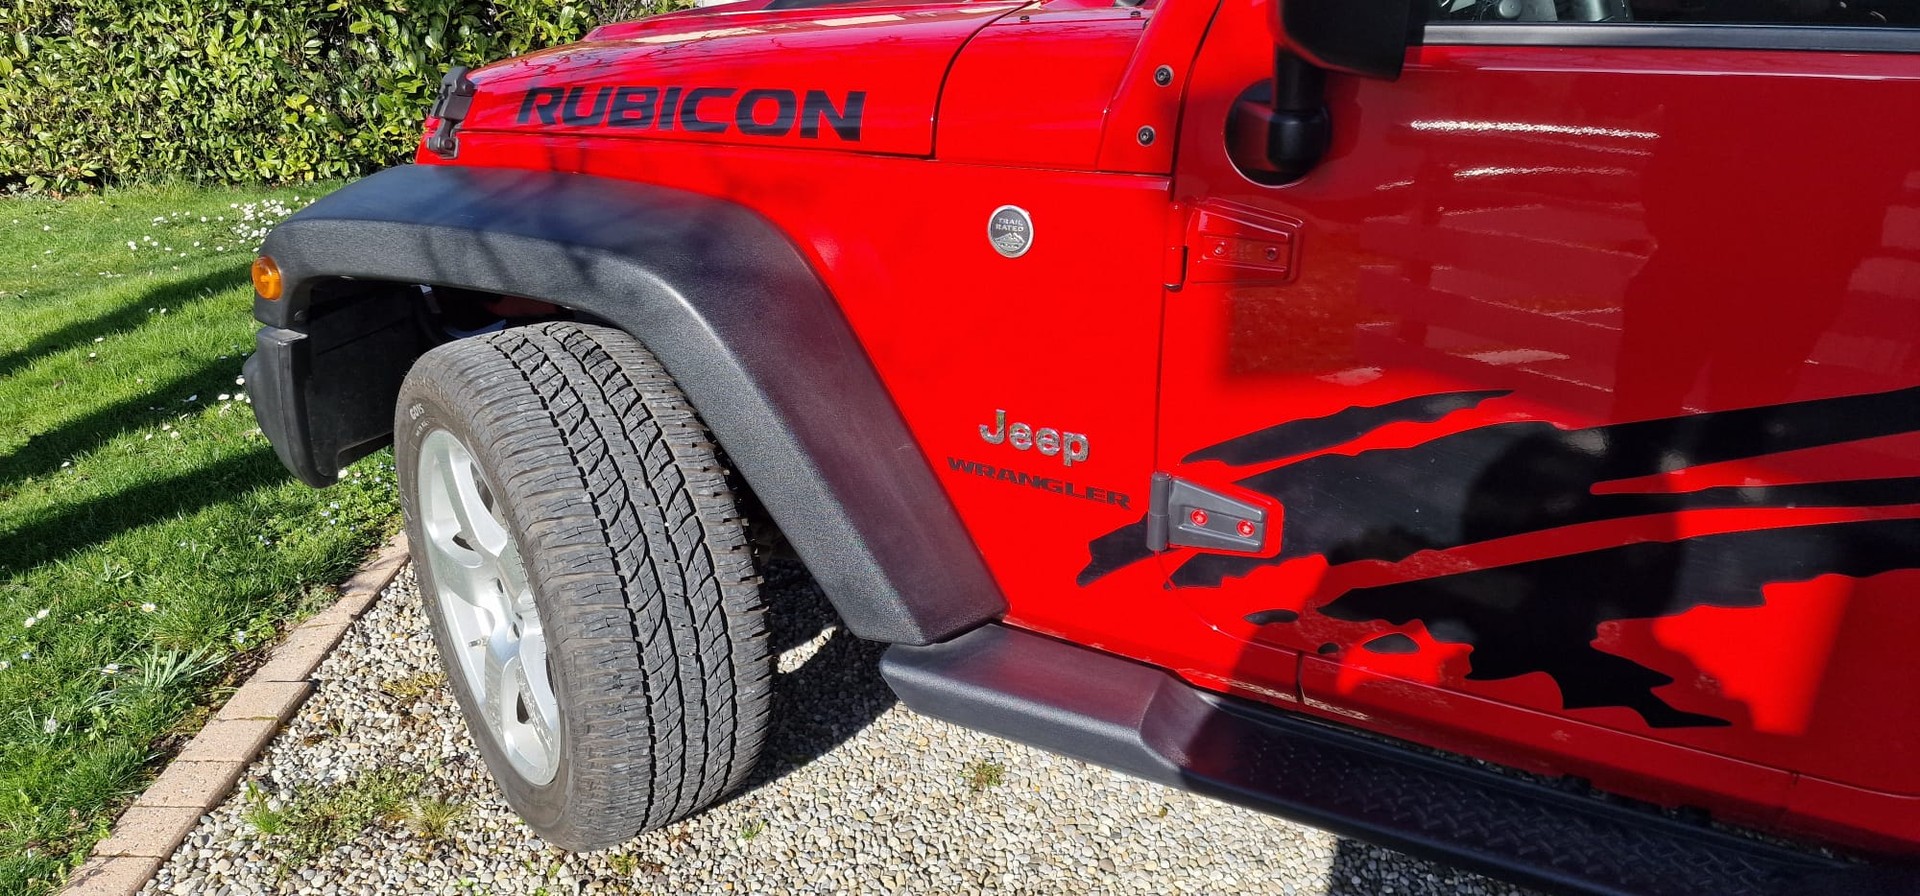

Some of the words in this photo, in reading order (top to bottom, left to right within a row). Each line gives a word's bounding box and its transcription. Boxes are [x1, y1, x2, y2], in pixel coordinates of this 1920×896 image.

[517, 86, 866, 141] RUBICON
[995, 223, 1024, 232] RATED
[998, 217, 1023, 226] TRAIL
[979, 408, 1090, 467] Jeep
[947, 456, 1131, 510] WRANGLER
